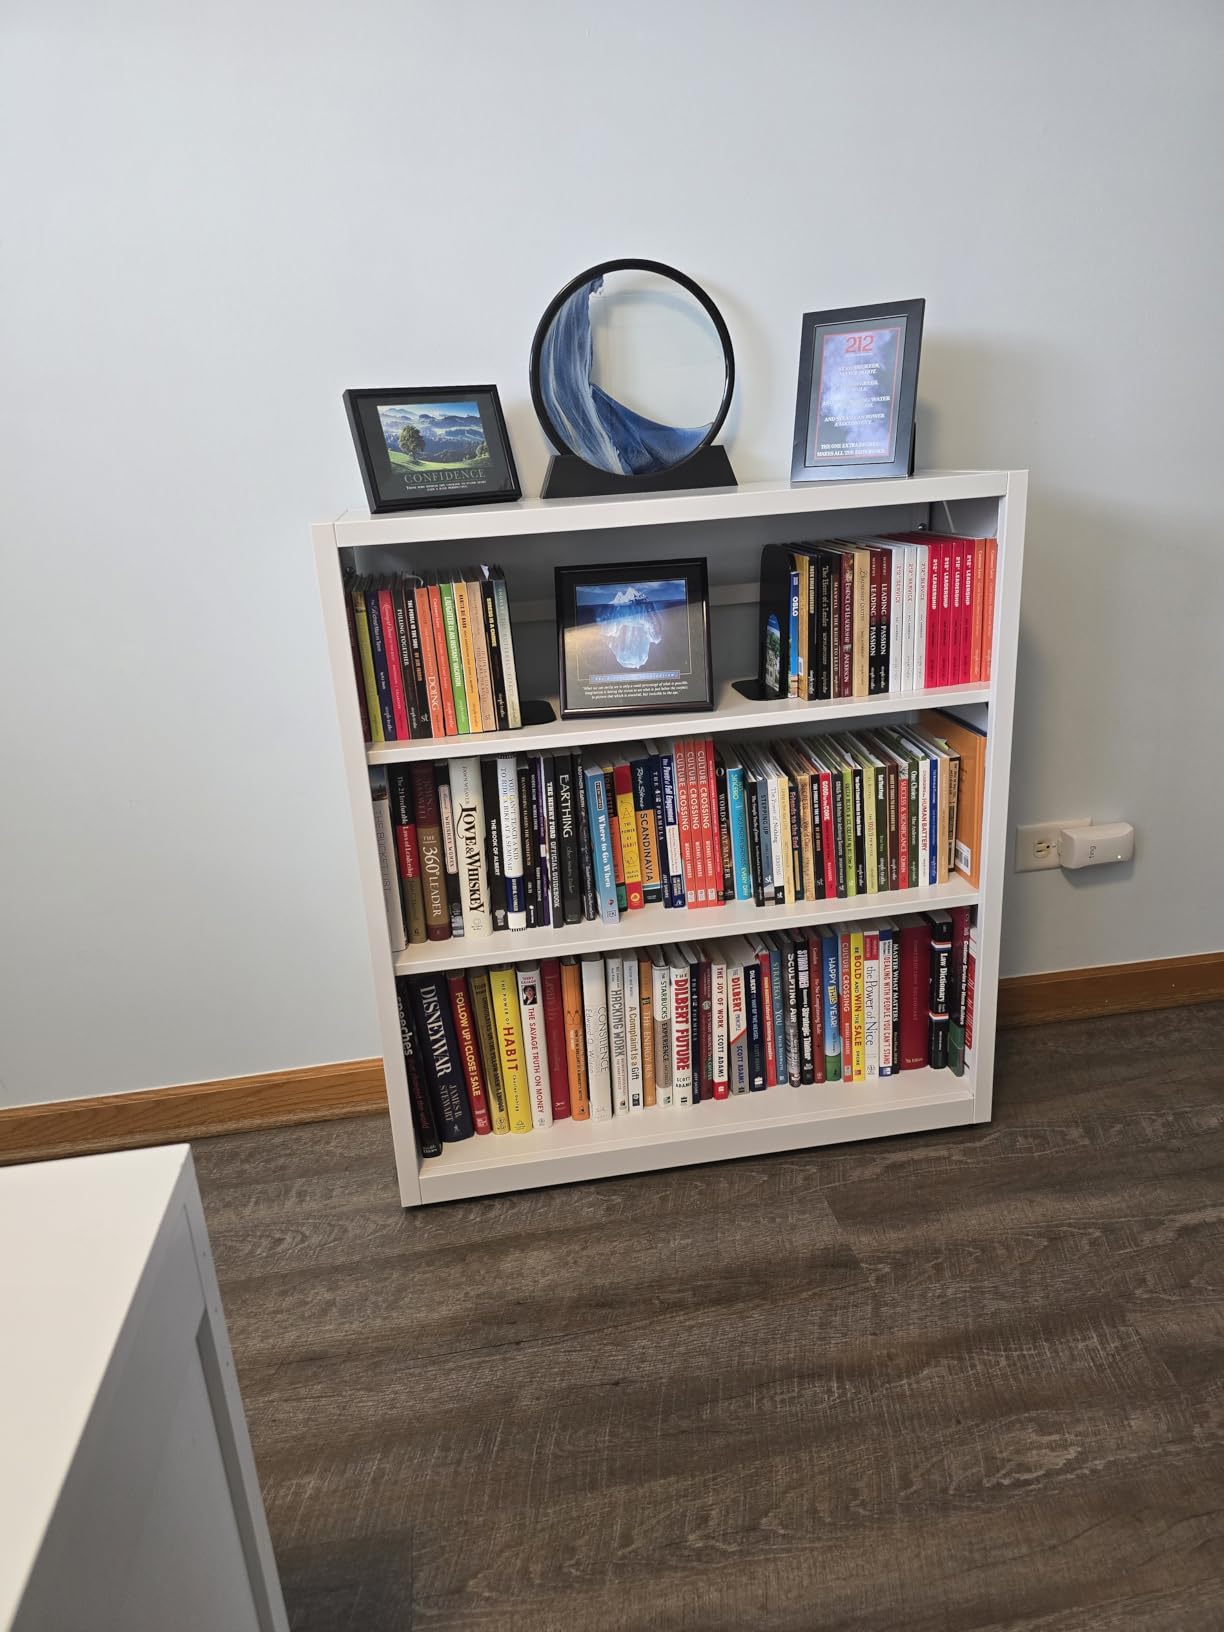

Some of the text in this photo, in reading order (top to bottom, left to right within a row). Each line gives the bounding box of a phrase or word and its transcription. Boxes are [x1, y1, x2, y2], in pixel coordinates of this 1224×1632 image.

[846, 336, 874, 353] 212
[404, 469, 486, 483] CONFIDENCE
[445, 597, 454, 625] LAUGHTER
[397, 609, 409, 666] PULLING TOGETHER
[450, 640, 458, 662] INSTANT
[452, 662, 461, 687] VACATION
[428, 677, 439, 710] DOING
[500, 768, 507, 778] TO
[504, 824, 510, 832] AT
[560, 775, 572, 837] EARTHING
[675, 753, 689, 831] CULTURE CROSSING
[687, 752, 700, 829] CULTURE CROSSING
[697, 751, 710, 828] CULTURE CROSSING
[719, 794, 727, 821] WORDS
[457, 804, 478, 846] LOVE
[598, 816, 608, 842] Where
[762, 826, 769, 834] UP
[601, 852, 610, 863] Go
[639, 813, 654, 882] SCANDINAVIA
[722, 845, 731, 879] MATTER
[422, 846, 441, 916] 360° LEADER
[465, 852, 485, 913] WHISKEY
[552, 872, 560, 907] GUIDEBOOK
[603, 865, 612, 887] When
[866, 966, 876, 979] the
[940, 953, 949, 966] Law
[732, 977, 742, 1012] DILBERT
[788, 954, 796, 1004] SCULPTING
[866, 981, 877, 1008] Power
[938, 968, 948, 1002] Dictionary
[420, 985, 452, 1078] DISNEYWAR
[529, 1023, 538, 1050] SAVAGE
[598, 1007, 608, 1072] CONSILIENCE
[611, 990, 625, 1057] HACKING WORK
[629, 1014, 638, 1052] Complaint
[675, 978, 690, 1070] DILBERT FUTURE
[802, 1008, 812, 1060] Strategic Thinker
[866, 1022, 878, 1046] Nice
[456, 992, 480, 1096] FOLLOW UP CLOSE SALE
[503, 1027, 518, 1071] HABIT
[532, 1052, 540, 1073] TRUTH
[631, 1067, 639, 1080] Gift
[449, 1085, 460, 1104] JAMES
[534, 1076, 541, 1086] ON
[439, 1085, 452, 1121] STEWART
[535, 1089, 544, 1113] MONEY
